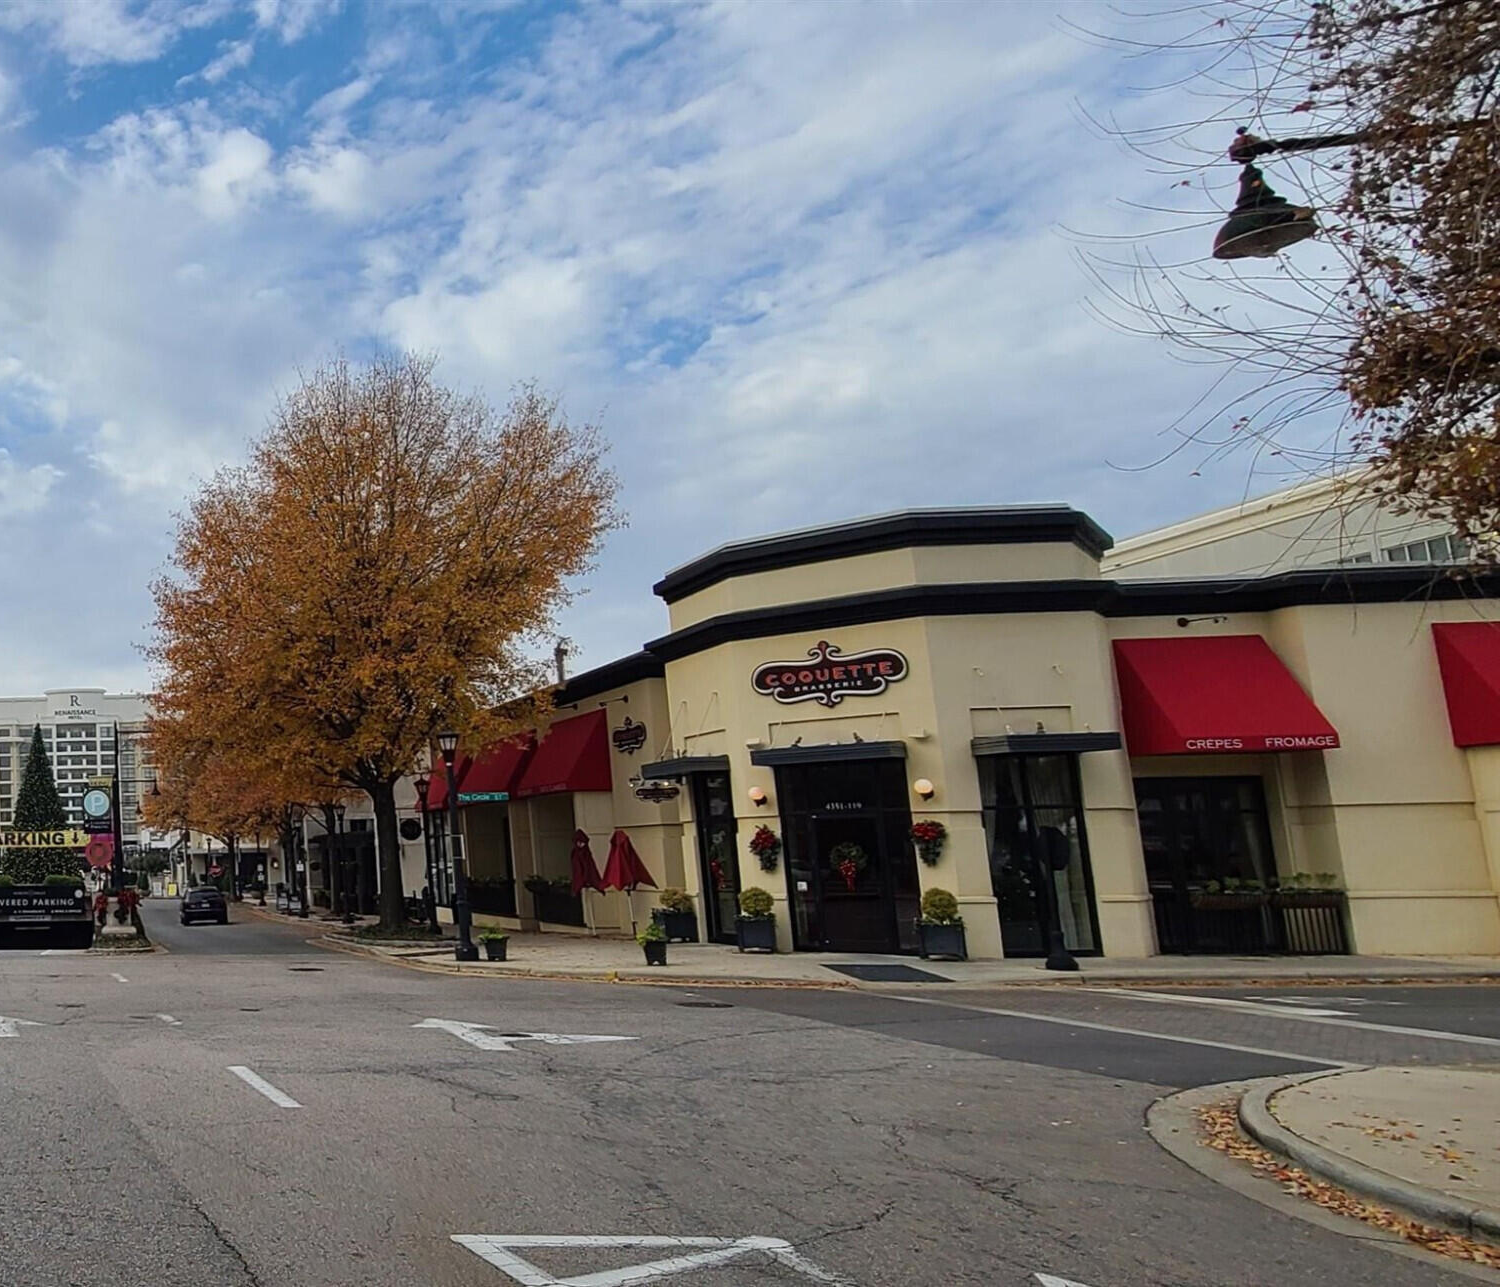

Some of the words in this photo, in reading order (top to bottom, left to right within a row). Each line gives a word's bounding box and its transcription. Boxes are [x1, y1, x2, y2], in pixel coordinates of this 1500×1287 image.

[765, 661, 893, 687] COQUETTE
[794, 680, 863, 693] BRASSERIE
[69, 694, 82, 707] R
[1265, 735, 1336, 748] FROMAGE
